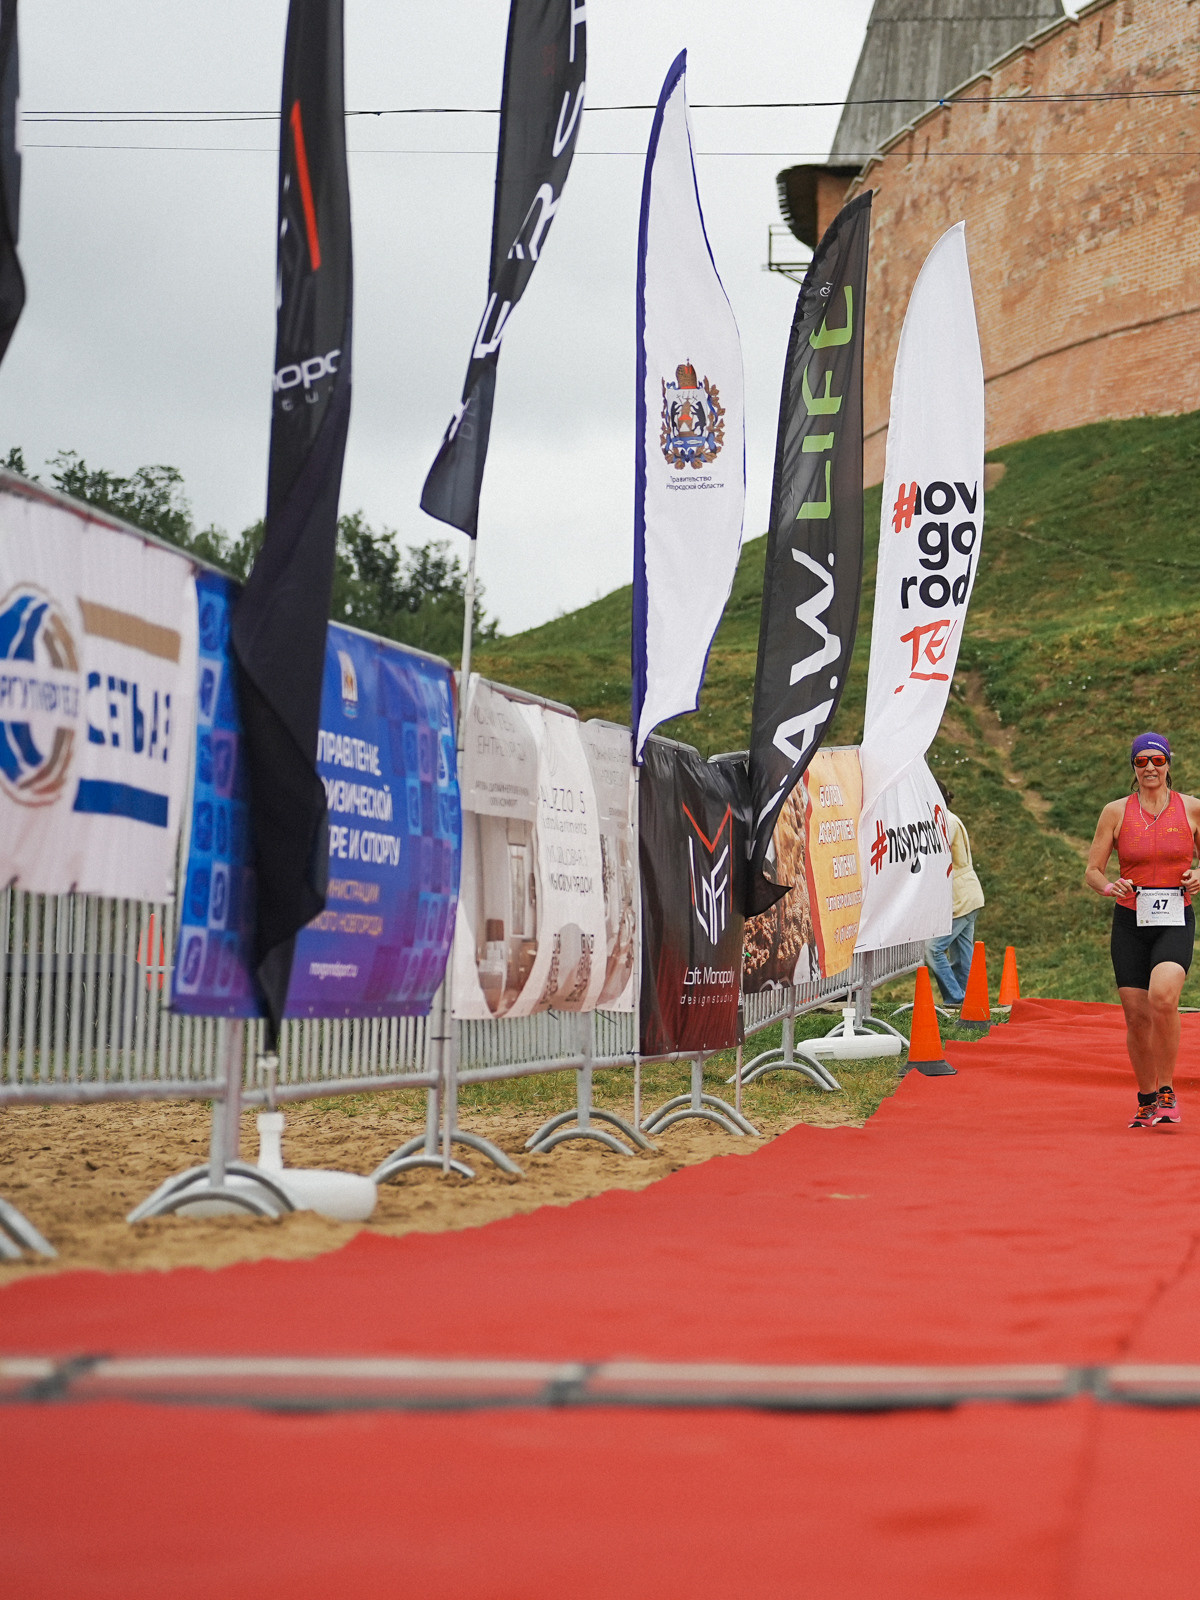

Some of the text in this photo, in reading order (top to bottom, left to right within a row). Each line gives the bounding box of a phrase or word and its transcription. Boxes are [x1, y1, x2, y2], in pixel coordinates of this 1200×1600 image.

[918, 521, 977, 571] go
[901, 554, 973, 609] rod
[1152, 899, 1168, 910] 47
